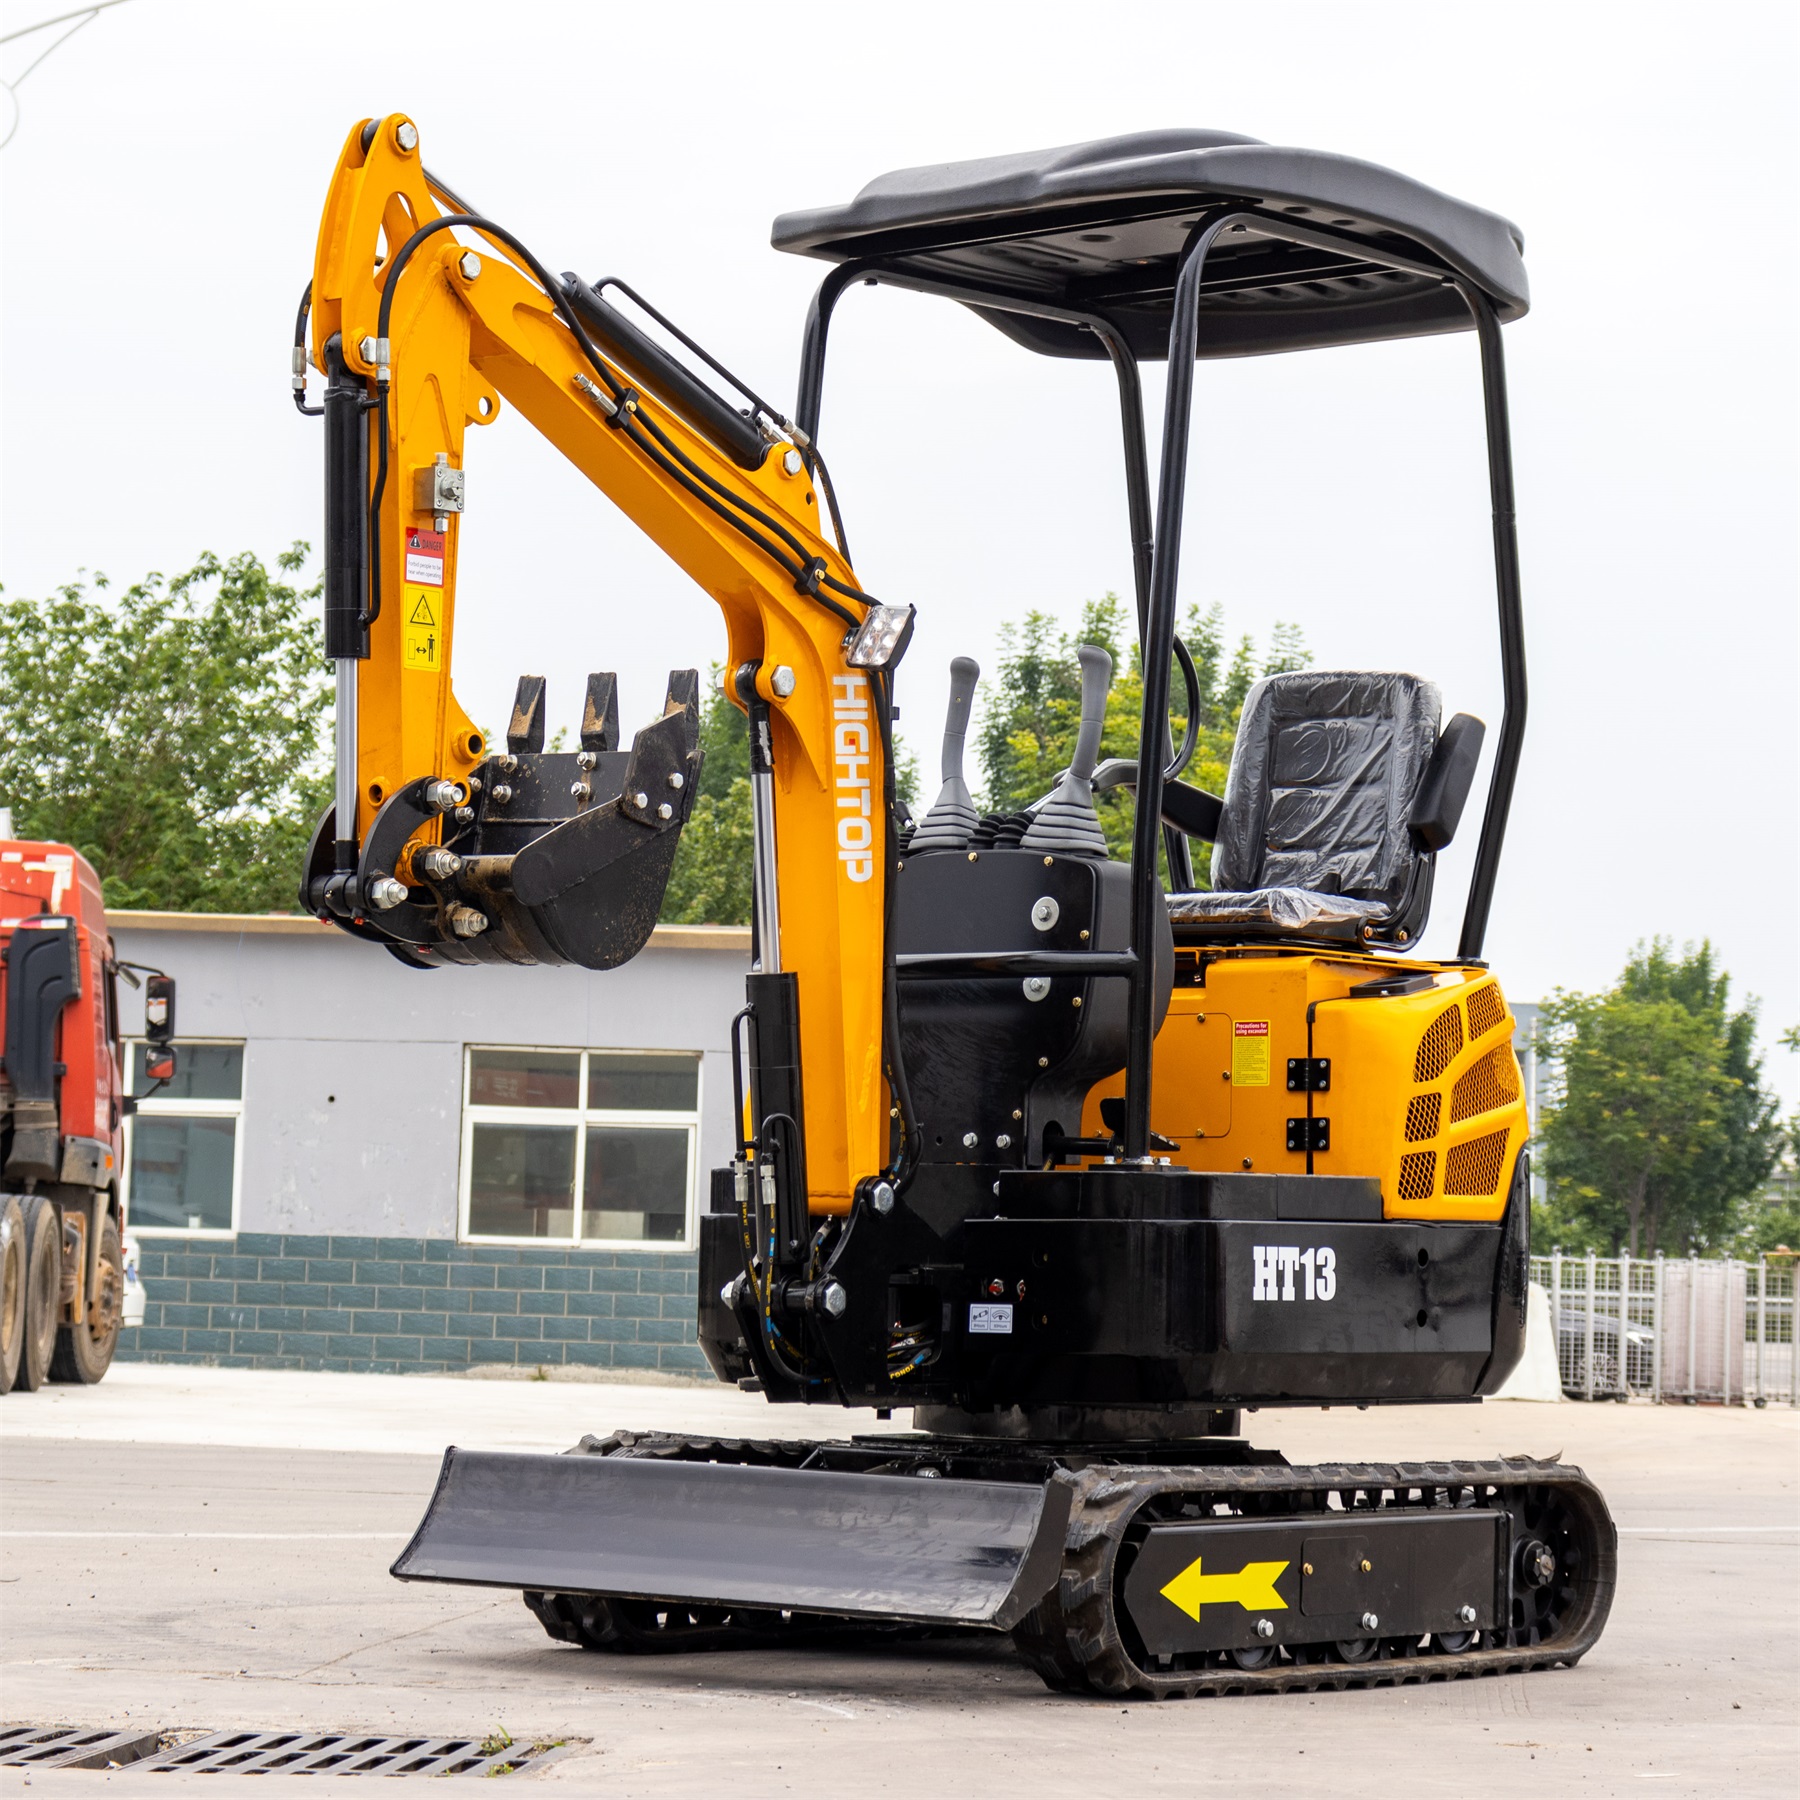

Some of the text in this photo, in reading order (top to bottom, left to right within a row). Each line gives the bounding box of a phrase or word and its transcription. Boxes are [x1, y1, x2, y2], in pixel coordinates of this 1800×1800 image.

[422, 539, 442, 551] DANGER
[833, 675, 873, 882] HIGHTOP
[1253, 1246, 1336, 1301] HT13
